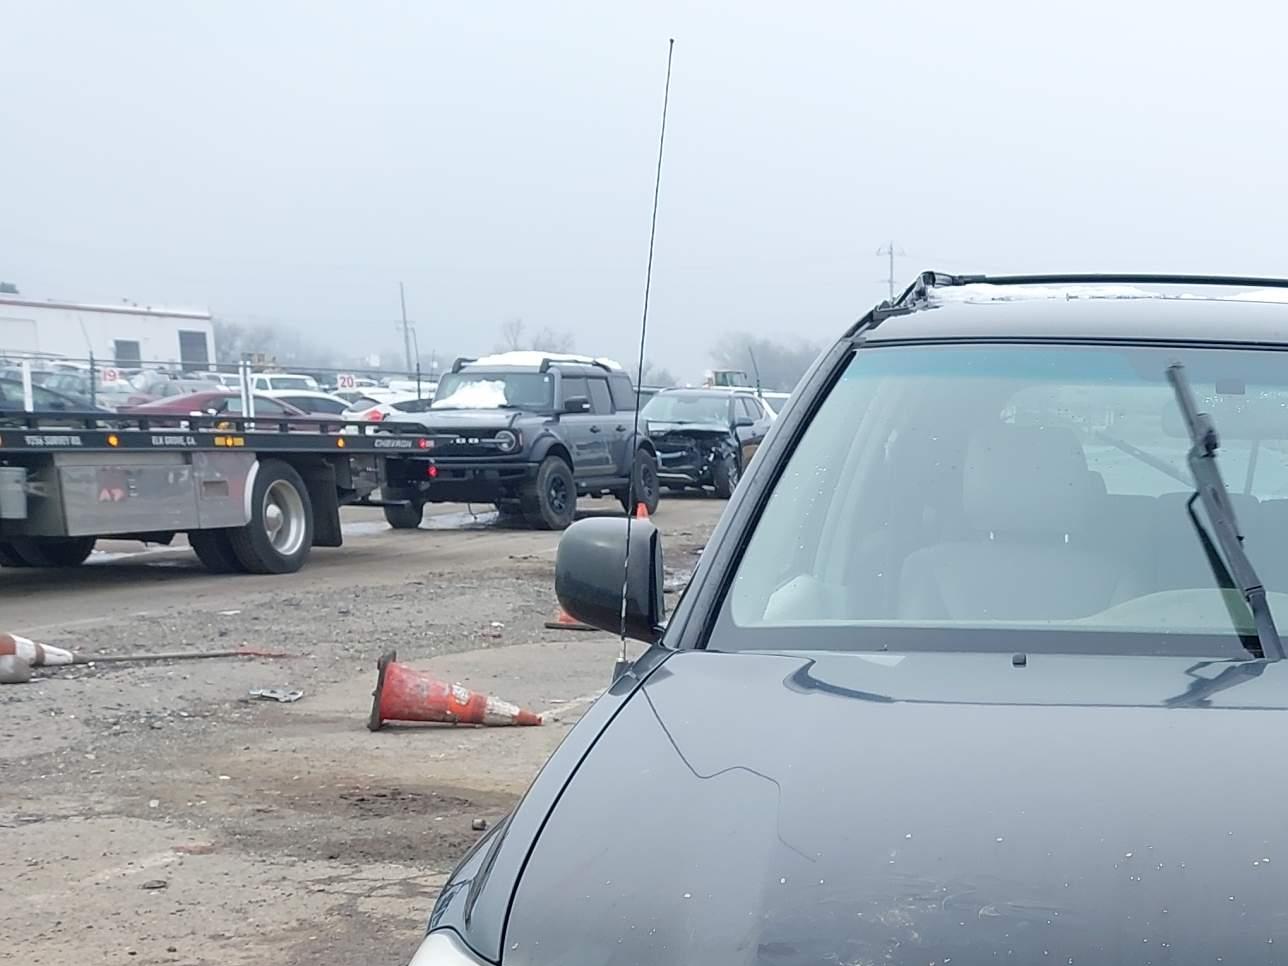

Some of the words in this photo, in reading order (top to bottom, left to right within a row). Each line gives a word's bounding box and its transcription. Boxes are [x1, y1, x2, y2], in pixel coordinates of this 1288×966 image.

[103, 368, 117, 382] 19
[339, 375, 354, 388] 20
[374, 438, 412, 448] CHEVRON
